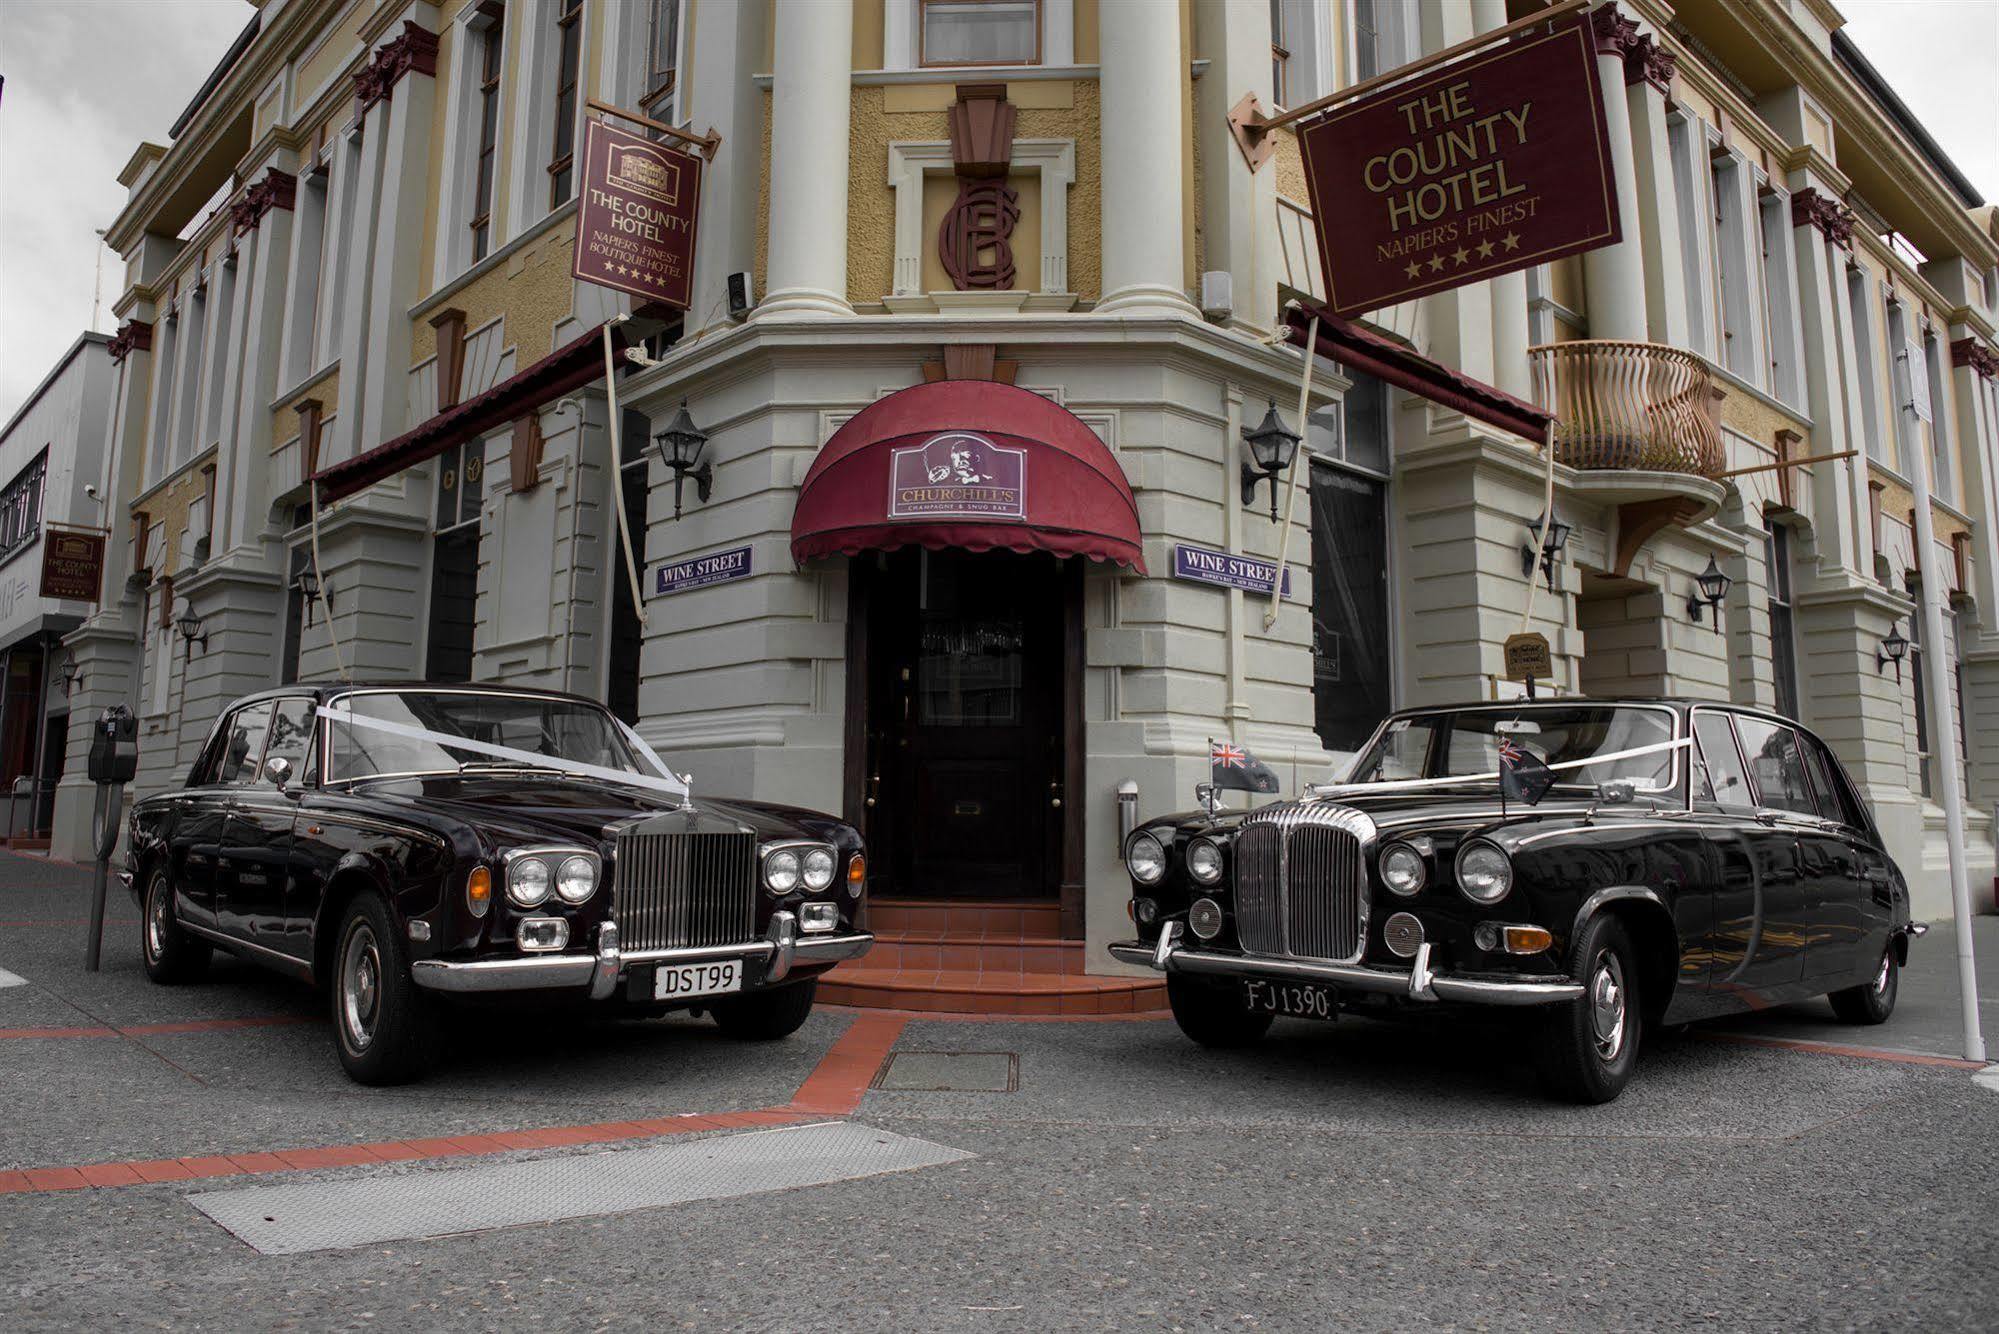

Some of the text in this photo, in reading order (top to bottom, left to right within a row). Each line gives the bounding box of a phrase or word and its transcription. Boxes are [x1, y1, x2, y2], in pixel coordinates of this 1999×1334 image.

[1398, 80, 1475, 135] THE
[1364, 102, 1532, 193] COUNTY
[590, 188, 690, 234] THE COUNTY
[1386, 159, 1526, 232] HOTEL
[611, 213, 665, 244] HOTEL
[1376, 196, 1541, 262] NAPIER'S FINEST
[589, 242, 683, 279] BOUTIQUE HOTEL
[592, 230, 681, 265] NAPIER'S FINEST
[902, 488, 1014, 503] CHURCHILL'S
[663, 551, 744, 583] WINE STREET
[1185, 551, 1225, 573] WINE
[665, 964, 734, 994] DST99
[1247, 982, 1328, 1016] FJ1390
